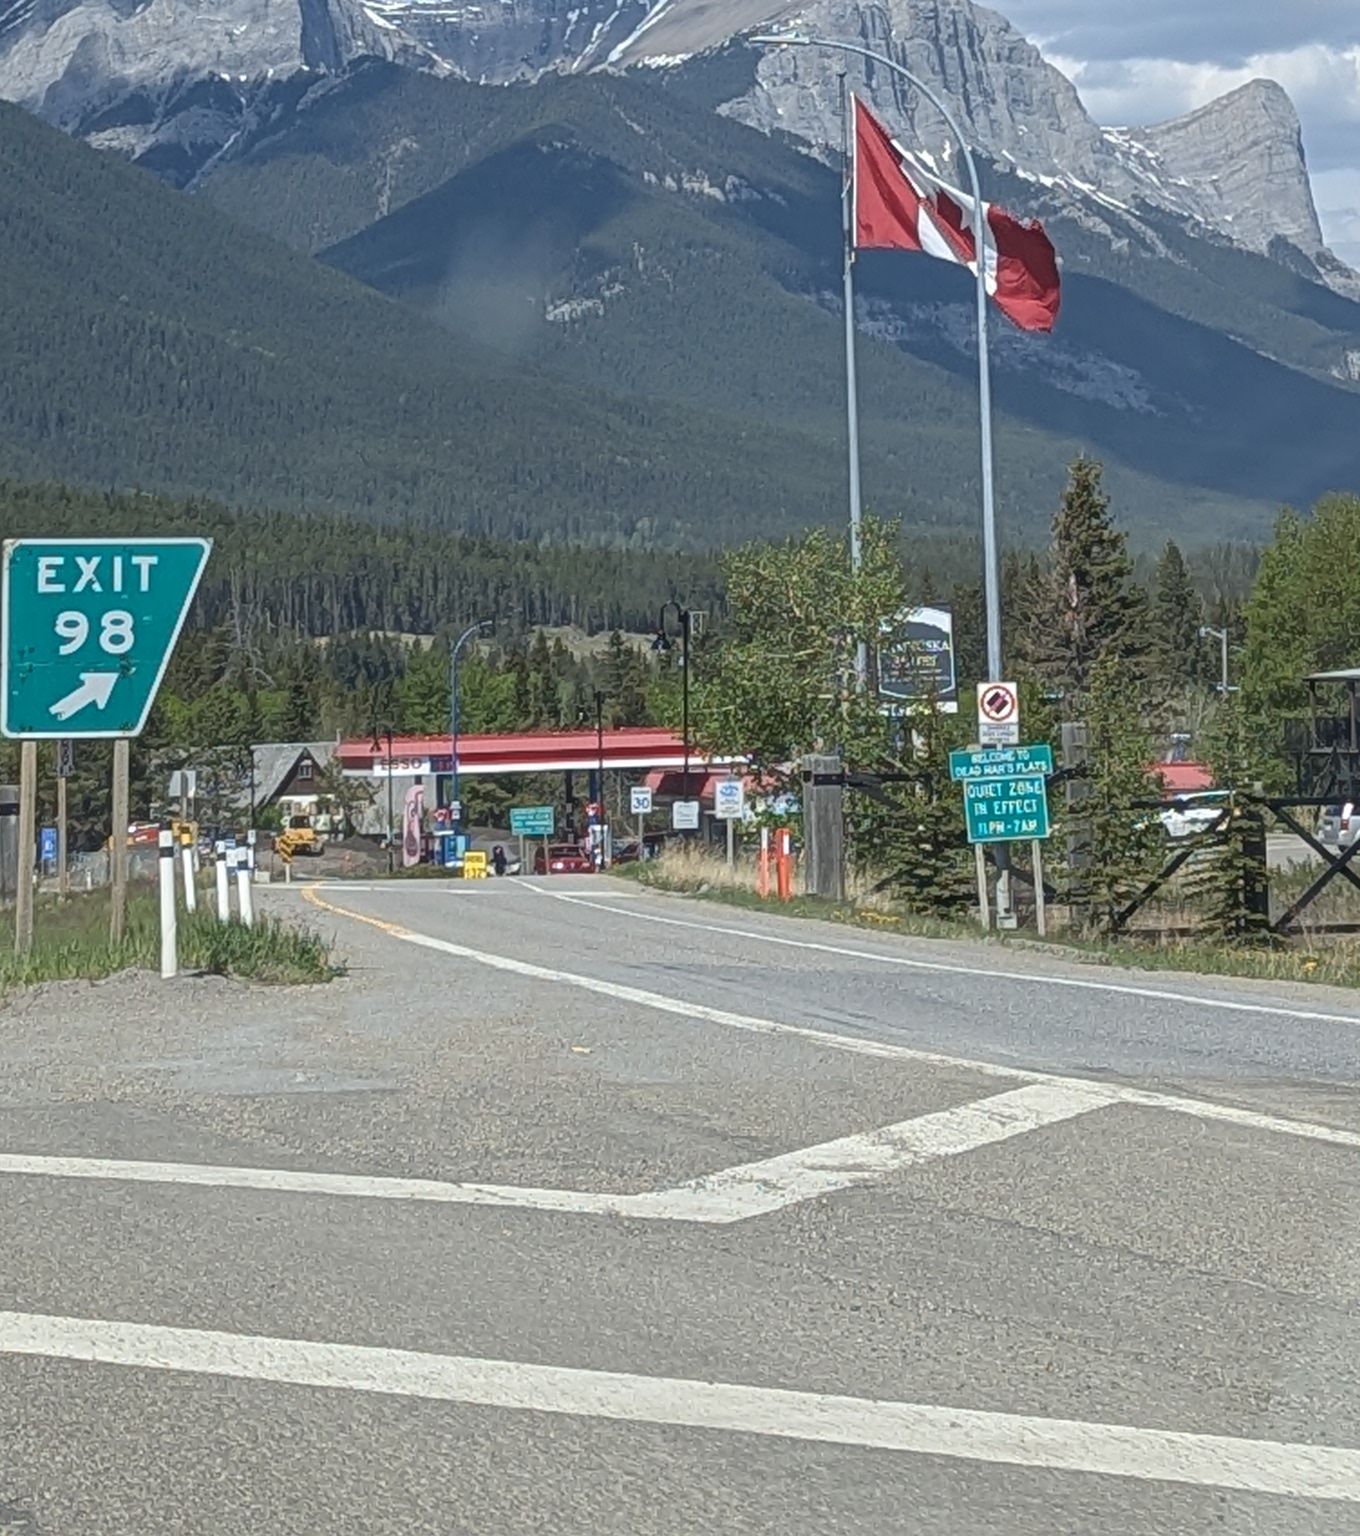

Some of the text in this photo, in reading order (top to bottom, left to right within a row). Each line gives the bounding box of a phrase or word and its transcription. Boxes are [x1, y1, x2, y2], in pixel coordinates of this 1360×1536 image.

[37, 556, 158, 593] EXIT
[54, 610, 135, 655] 98
[1017, 749, 1030, 761] TO
[968, 781, 1042, 798] QUIET ZONE
[633, 797, 650, 809] 30
[993, 799, 1037, 815] EFFECT
